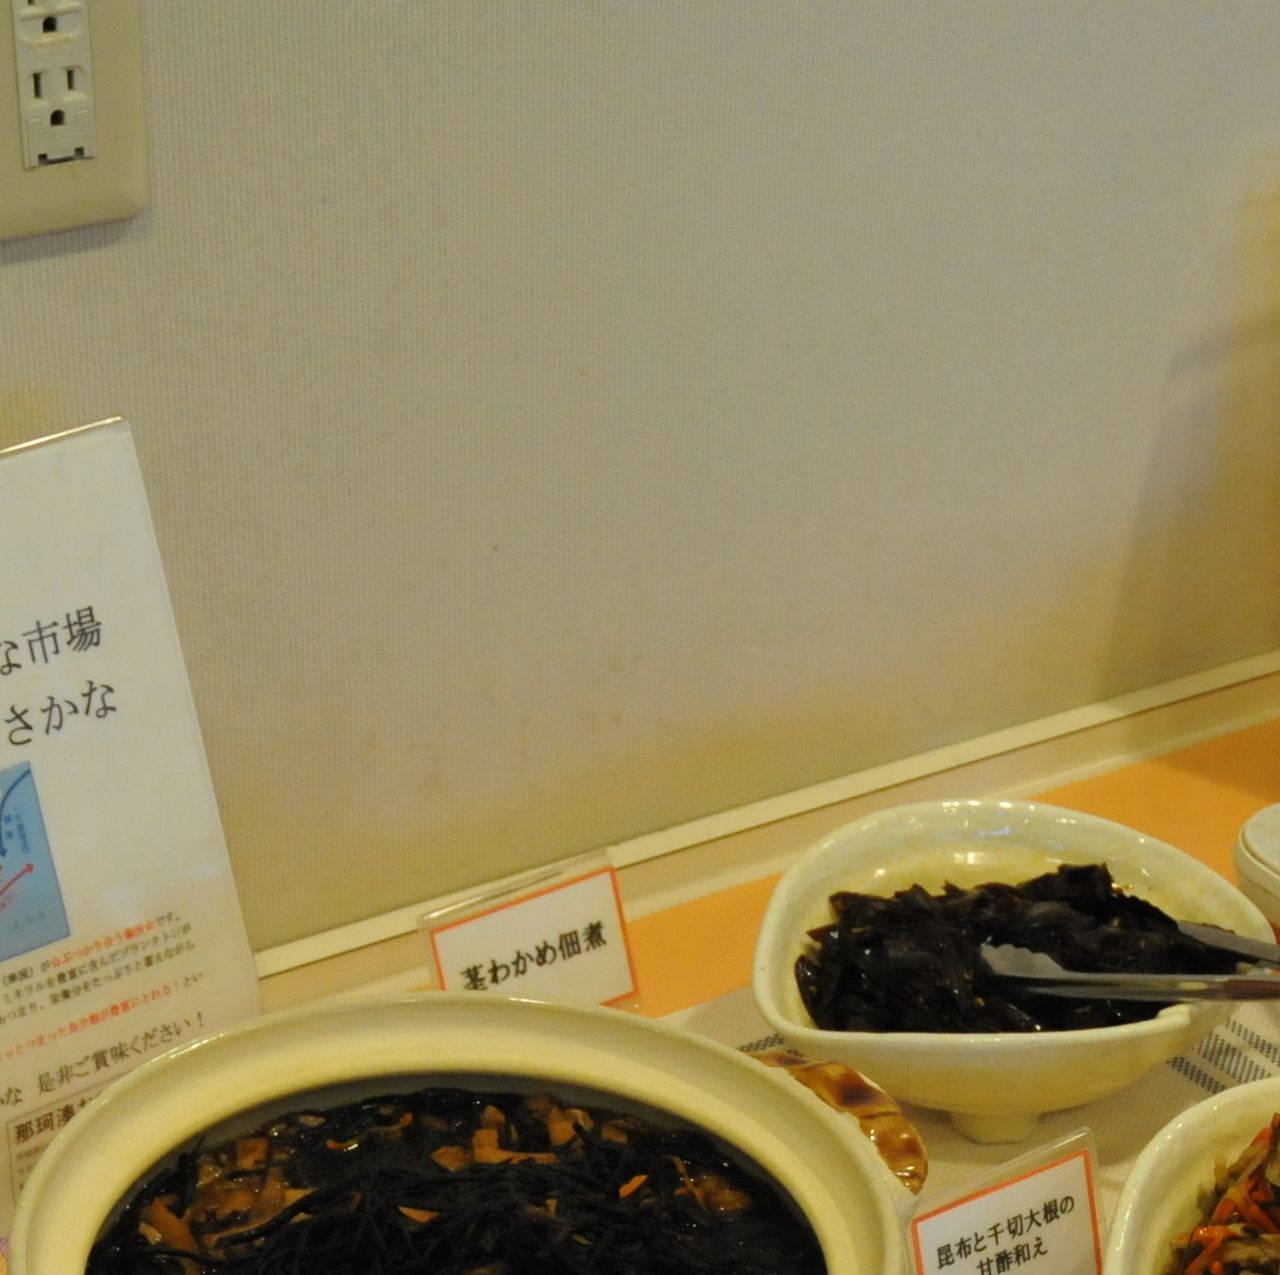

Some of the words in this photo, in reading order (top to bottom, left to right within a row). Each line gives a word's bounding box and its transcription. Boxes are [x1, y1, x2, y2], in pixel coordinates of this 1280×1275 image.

[460, 920, 608, 991] 茎わかめ佃煮
